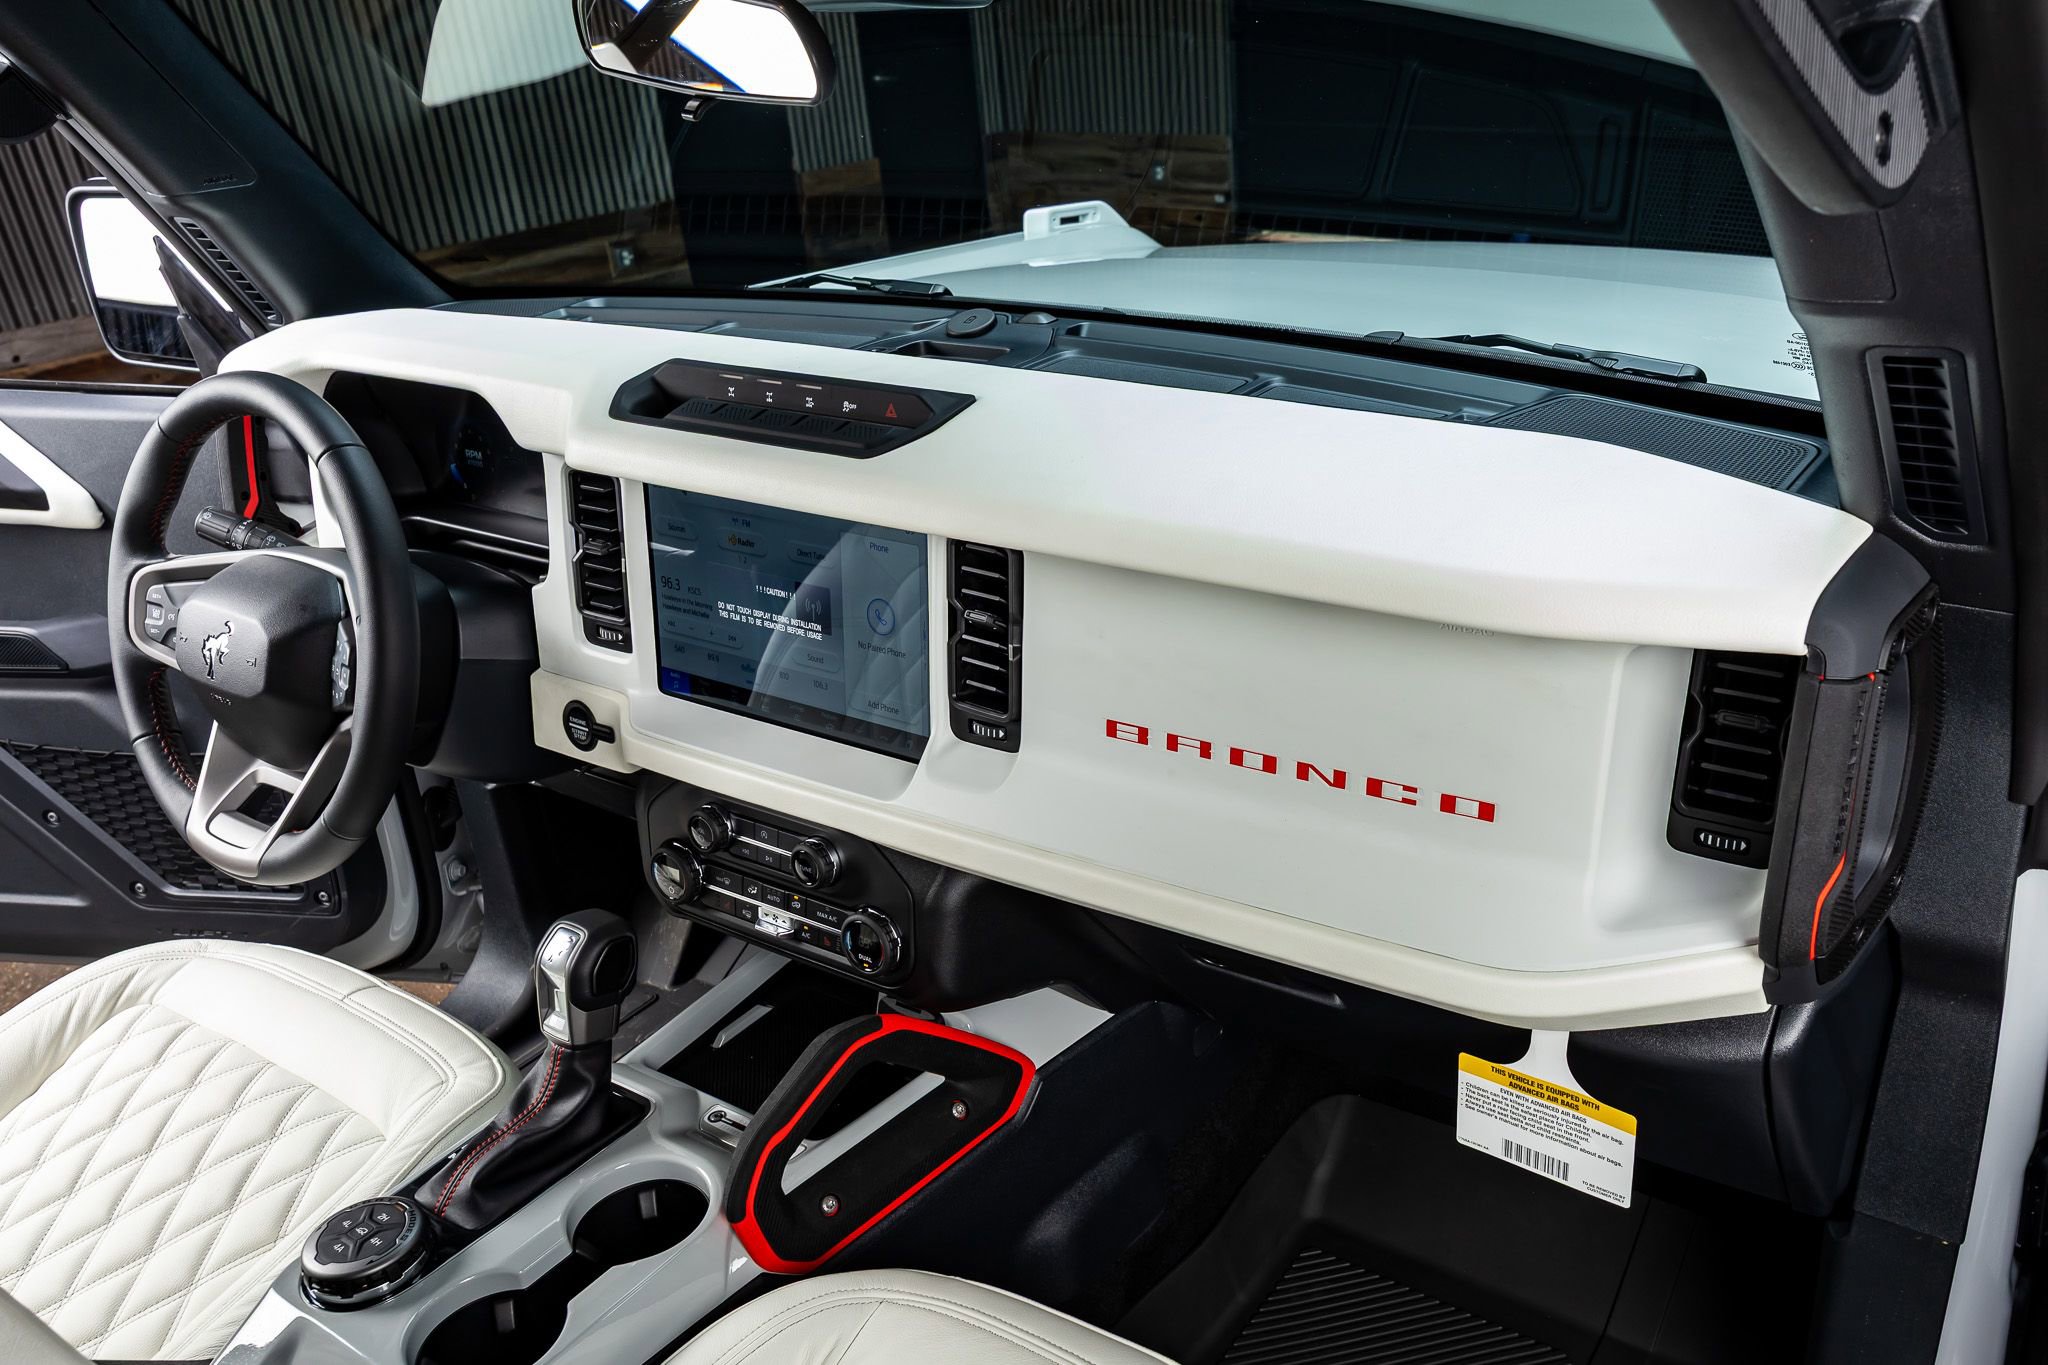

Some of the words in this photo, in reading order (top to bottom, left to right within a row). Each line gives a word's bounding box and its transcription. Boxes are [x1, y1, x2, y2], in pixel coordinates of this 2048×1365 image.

[465, 449, 482, 460] RPM
[869, 542, 889, 554] Phone
[660, 575, 680, 591] 96.3
[718, 601, 724, 609] DO
[726, 603, 735, 611] NOT
[737, 606, 751, 615] TOUCH
[753, 609, 770, 620] DISPLAY
[772, 614, 789, 624] DURING
[791, 618, 821, 632] INSTALLATION
[719, 610, 728, 618] THIS
[730, 612, 740, 621] FILM
[741, 615, 746, 623] IS
[748, 616, 754, 625] TO
[756, 618, 762, 627] BE
[764, 620, 785, 632] REMOVED
[787, 625, 805, 636] BEFORE
[807, 630, 822, 641] USAGE
[807, 653, 824, 665] Sound
[858, 641, 866, 650] No
[867, 643, 886, 654] Paired
[887, 647, 906, 659] Phone
[868, 700, 879, 710] Add
[880, 703, 899, 715] Phone
[570, 716, 587, 726] ENGINE
[1105, 718, 1496, 823] BRONCO
[767, 893, 780, 903] AUTO
[816, 911, 828, 919] MAX
[828, 914, 838, 923] A/C
[801, 931, 811, 939] A/C
[858, 953, 872, 964] DUAL
[1491, 1065, 1506, 1077] THIS
[1508, 1070, 1535, 1088] VEHICLE
[1537, 1082, 1543, 1090] IS
[1546, 1084, 1579, 1105] EQUIPPED
[1582, 1098, 1600, 1111] WITH
[1509, 1079, 1544, 1100] ADVANCED
[1547, 1094, 1558, 1104] AIR
[1561, 1098, 1579, 1112] BAGS
[1466, 1087, 1476, 1095] The
[1477, 1091, 1490, 1100] back
[1491, 1097, 1503, 1105] seat
[1521, 1108, 1537, 1118] safest
[1539, 1114, 1554, 1126] place
[1565, 1124, 1591, 1138] Children.
[1466, 1081, 1488, 1095] Children
[1490, 1091, 1500, 1099] can
[1510, 1098, 1524, 1108] killed
[1533, 1106, 1559, 1121] seriously
[1561, 1116, 1581, 1129] injured
[1591, 1128, 1600, 1136] the
[1611, 1136, 1624, 1146] bag.
[1500, 1087, 1513, 1098] EVEN
[1515, 1093, 1529, 1104] WITH
[1531, 1098, 1559, 1115] ADVANCED
[1561, 1109, 1570, 1118] AIR
[1572, 1113, 1587, 1124] BAGS
[1465, 1092, 1481, 1102] Never
[1483, 1099, 1491, 1107] put
[1497, 1105, 1508, 1113] rear
[1510, 1109, 1526, 1121] facing
[1528, 1116, 1542, 1126] child
[1543, 1122, 1555, 1131] seat
[1564, 1129, 1573, 1137] the
[1575, 1133, 1590, 1144] front.
[1465, 1097, 1484, 1110] Always
[1486, 1106, 1496, 1114] use
[1497, 1110, 1508, 1118] seat
[1510, 1115, 1523, 1124] belts
[1525, 1120, 1535, 1129] and
[1537, 1125, 1550, 1135] child
[1552, 1130, 1581, 1146] restraints.
[1465, 1103, 1475, 1111] See
[1476, 1107, 1497, 1120] owner's
[1499, 1116, 1519, 1128] manual
[1530, 1128, 1544, 1138] more
[1545, 1133, 1578, 1151] information
[1580, 1147, 1596, 1158] about
[1607, 1157, 1623, 1169] bags.
[1587, 1186, 1611, 1199] CUSTOMER
[1613, 1196, 1624, 1204] ONLY
[1596, 1186, 1618, 1197] REMOVED
[400, 1209, 417, 1242] MODES
[370, 1236, 383, 1247] 4H
